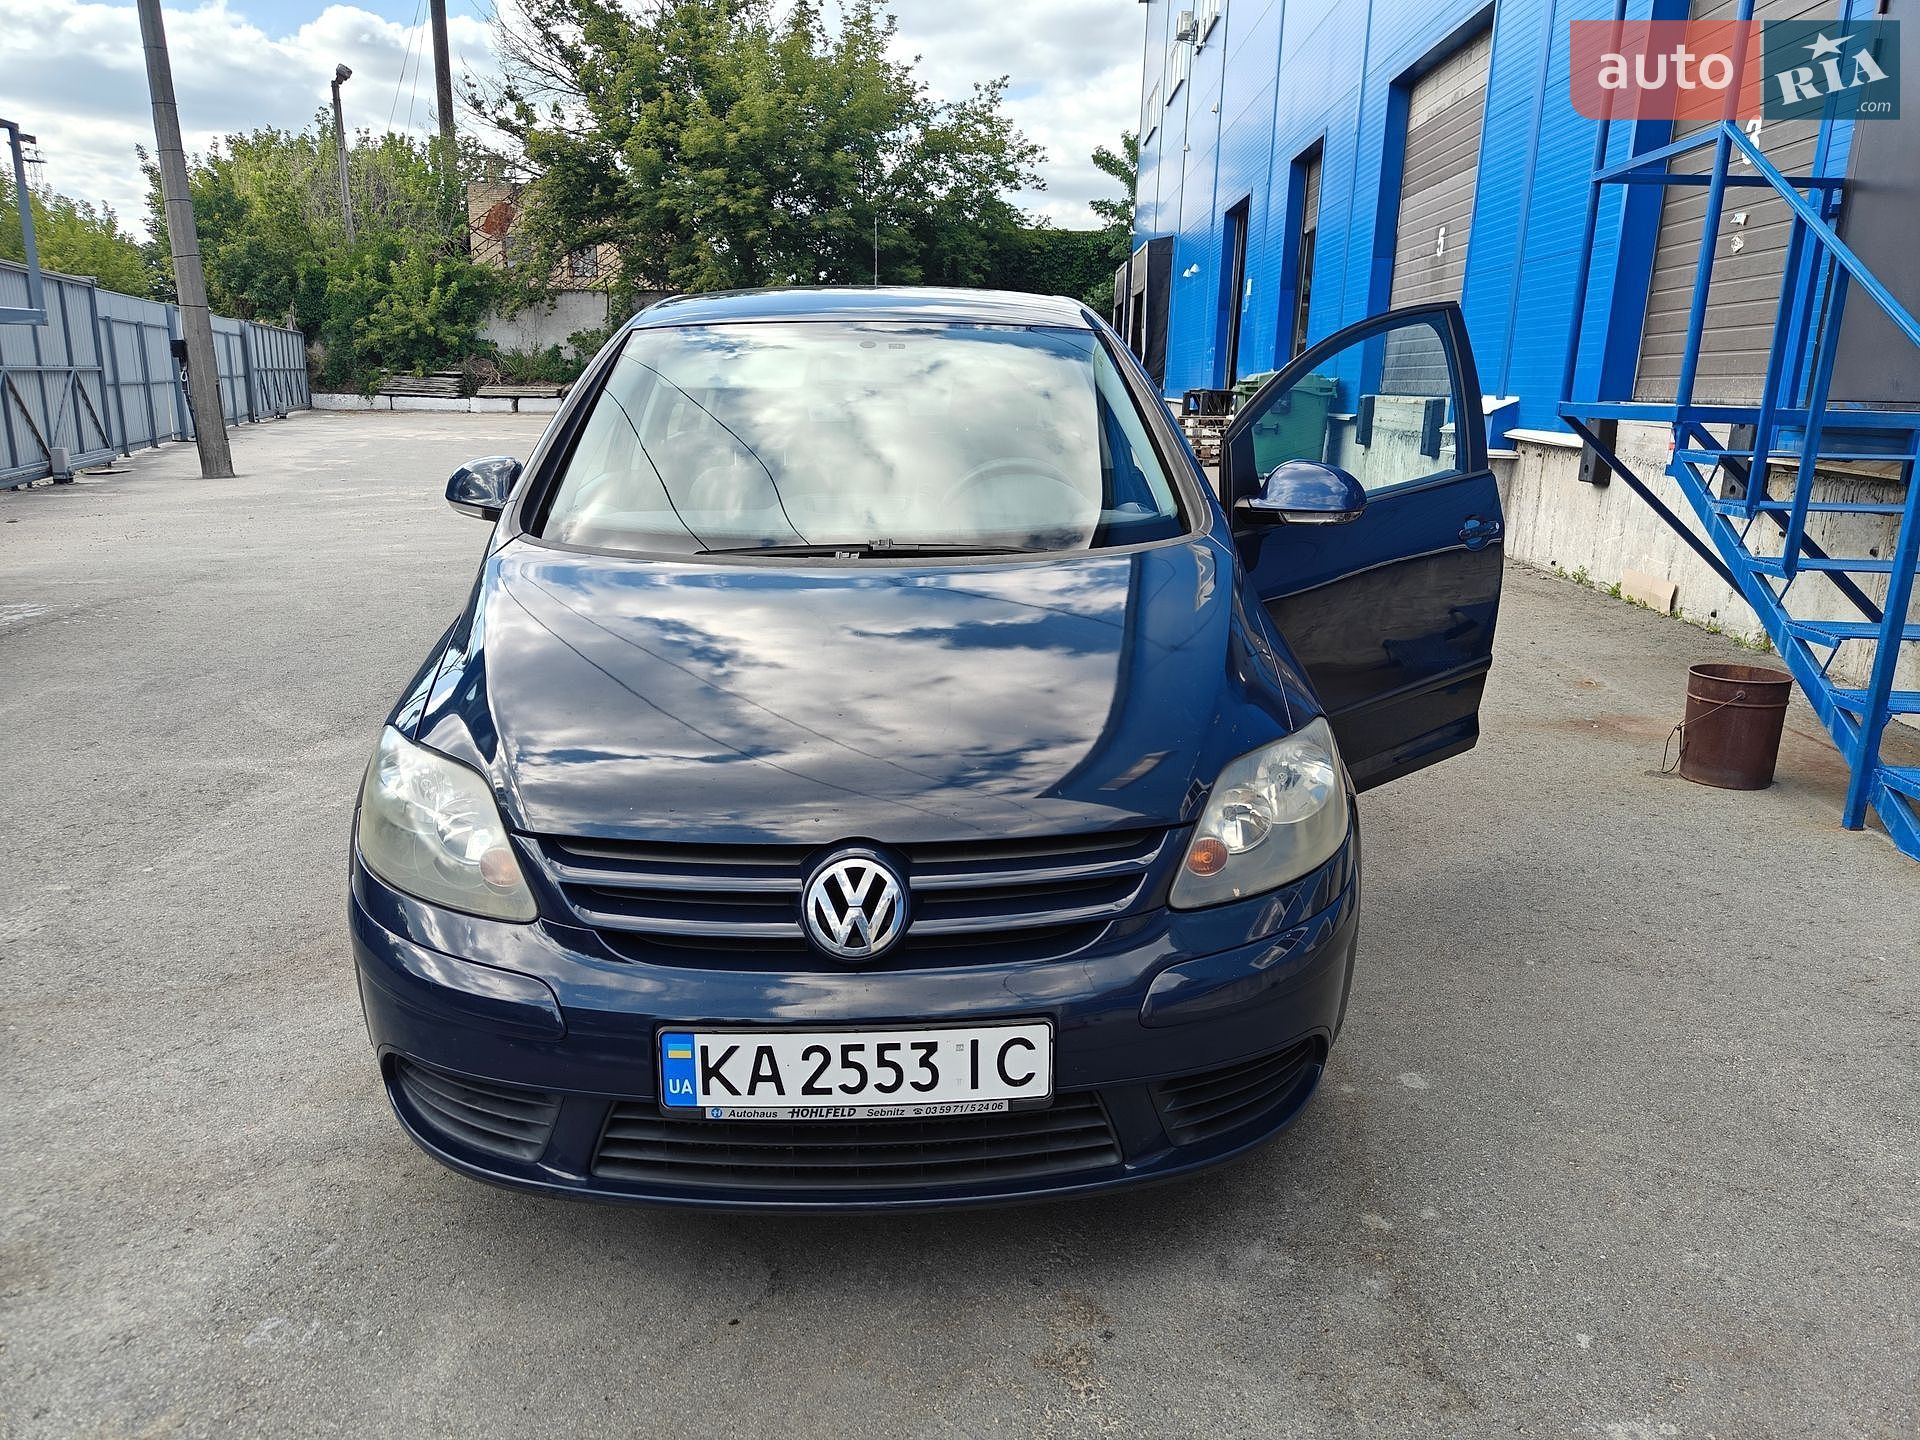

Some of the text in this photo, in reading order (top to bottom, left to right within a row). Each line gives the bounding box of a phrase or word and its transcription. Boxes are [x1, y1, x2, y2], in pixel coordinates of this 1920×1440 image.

[699, 1044, 787, 1097] KA
[800, 1040, 940, 1097] 2553
[669, 1078, 694, 1095] UA
[728, 1109, 778, 1118] Autohaus
[788, 1107, 856, 1118] HOHLFELD
[866, 1107, 905, 1117] Sebnitz
